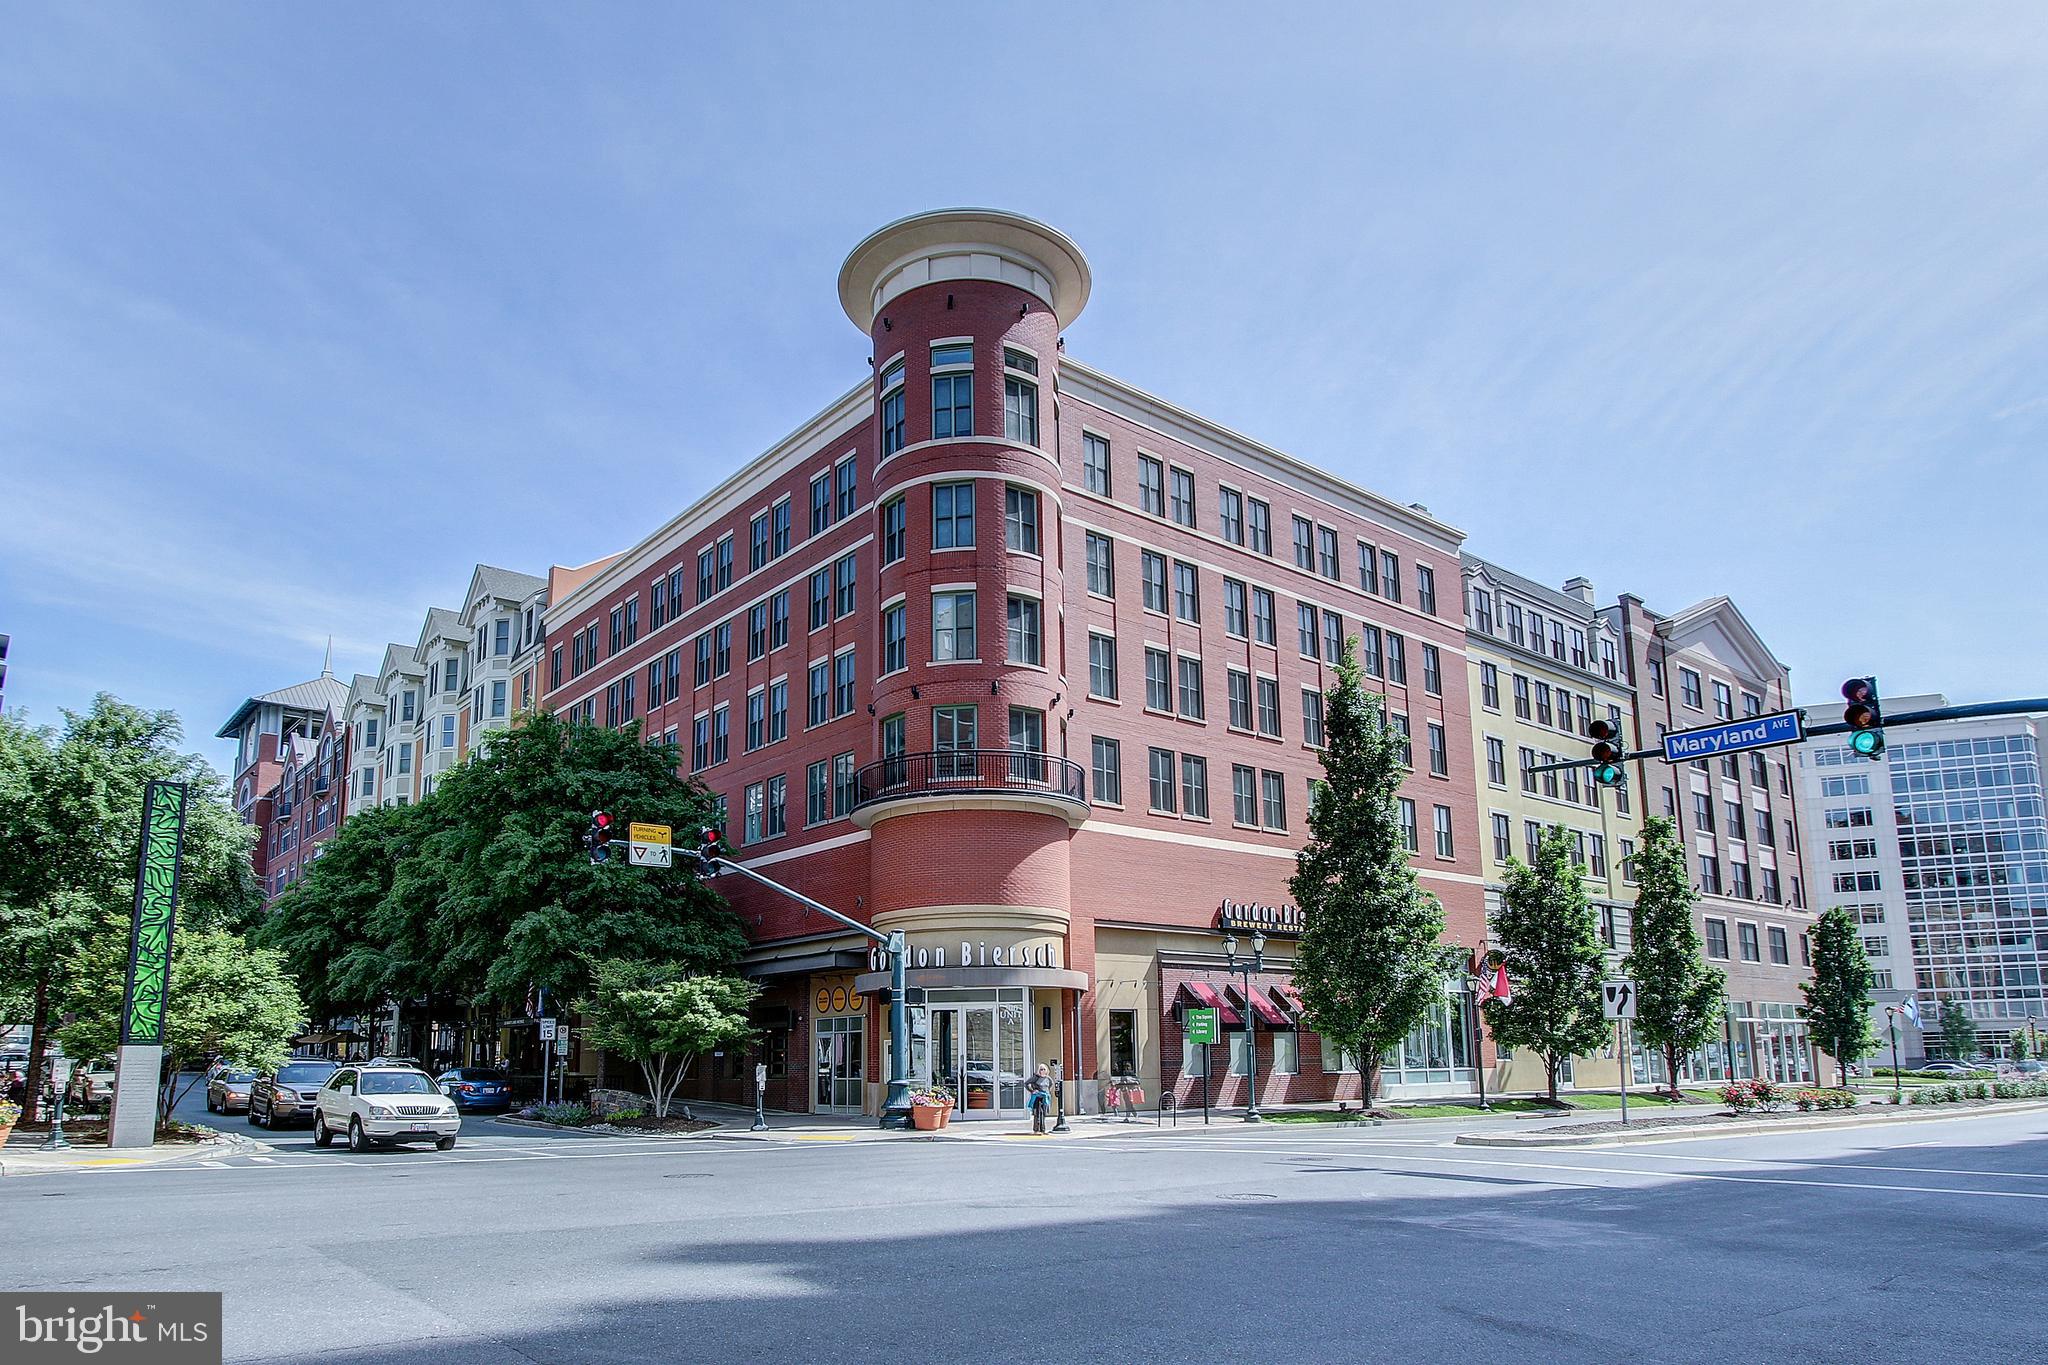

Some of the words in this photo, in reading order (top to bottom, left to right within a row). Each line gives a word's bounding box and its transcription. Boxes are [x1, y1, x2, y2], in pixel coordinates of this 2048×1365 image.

[1672, 723, 1768, 755] Maryland
[1771, 718, 1791, 730] AVE
[633, 826, 657, 834] TURNING
[633, 833, 657, 841] VEHICLES
[1222, 897, 1277, 923] Gordon
[1230, 919, 1274, 931] BREWERY
[1277, 923, 1305, 933] RESTA
[961, 941, 1057, 967] Biersch
[1000, 1011, 1022, 1019] UNIT
[543, 1029, 553, 1038] 15
